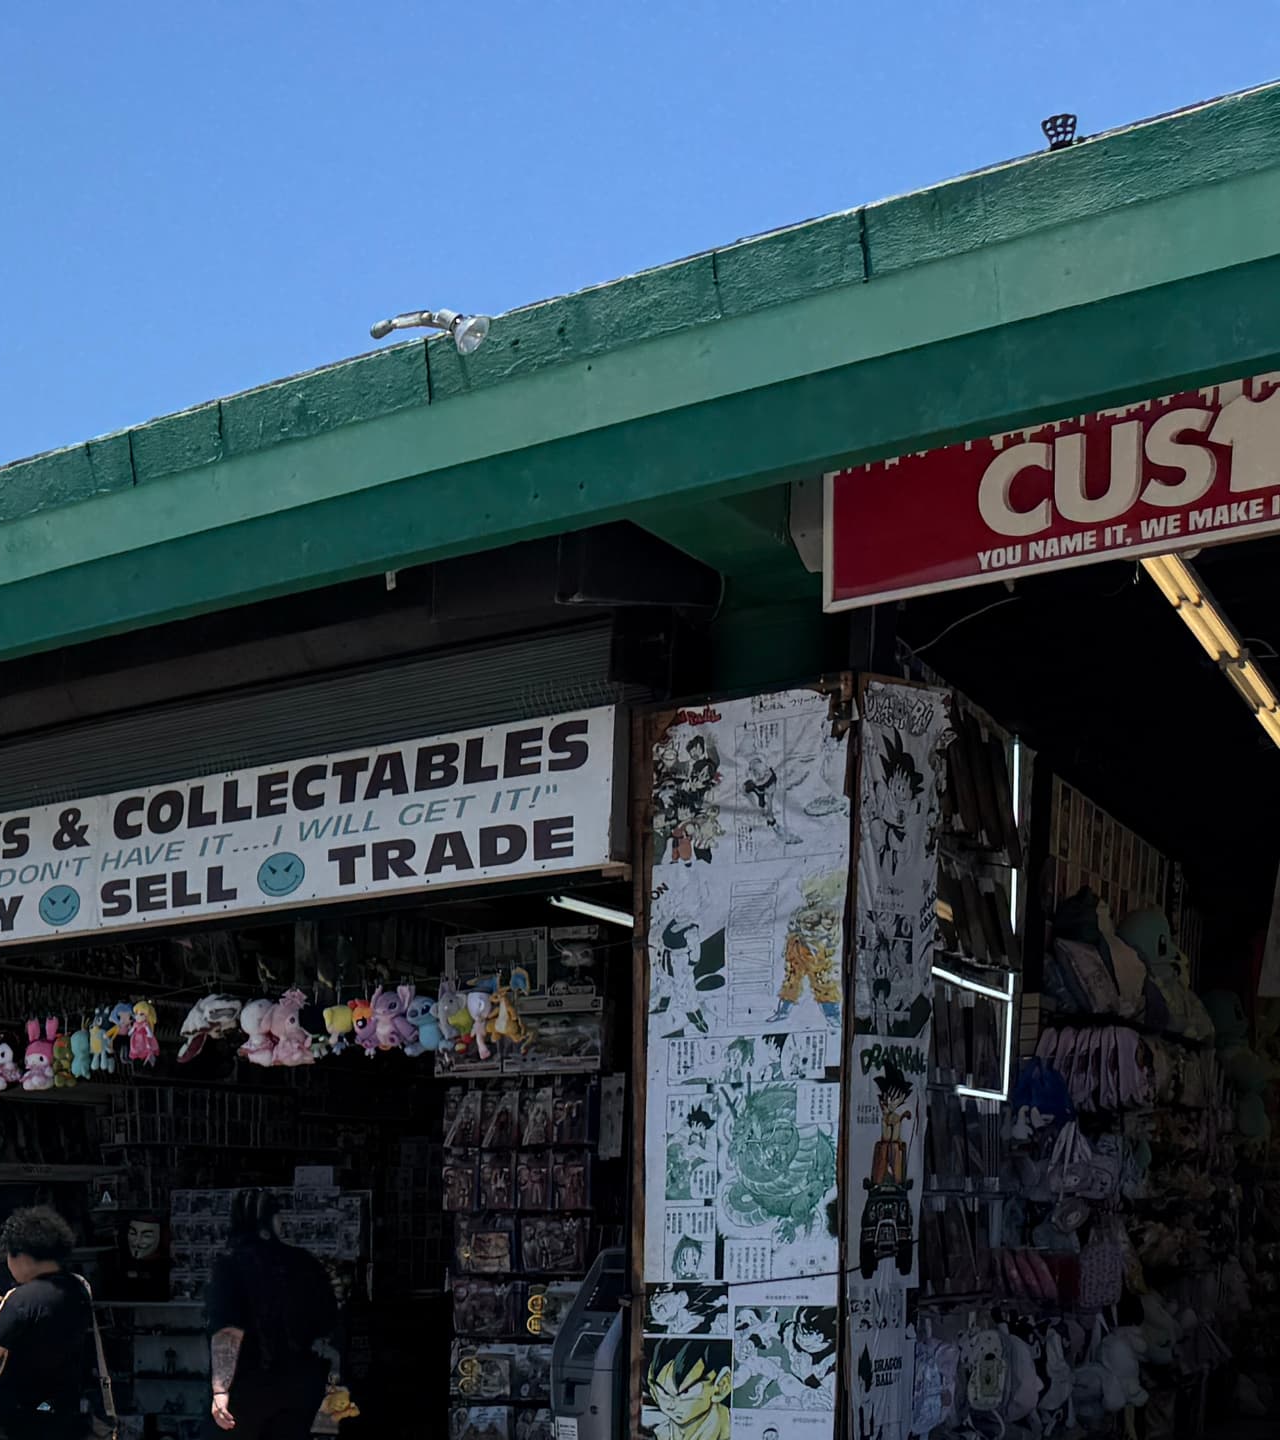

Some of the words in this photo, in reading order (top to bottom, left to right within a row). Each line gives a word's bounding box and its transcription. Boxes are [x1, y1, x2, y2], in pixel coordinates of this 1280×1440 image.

[977, 546, 1022, 570] YOU
[1028, 531, 1097, 560] NAME
[1104, 524, 1133, 546] IT,
[1140, 514, 1181, 540] WE
[1189, 498, 1265, 531] MAKE
[52, 807, 91, 851] &
[113, 719, 589, 841] COLLECTABLES
[100, 840, 186, 872] HAVE
[298, 810, 381, 842] WILL
[398, 795, 477, 827] GET
[100, 865, 238, 918] SELL
[328, 815, 575, 886] TRADE
